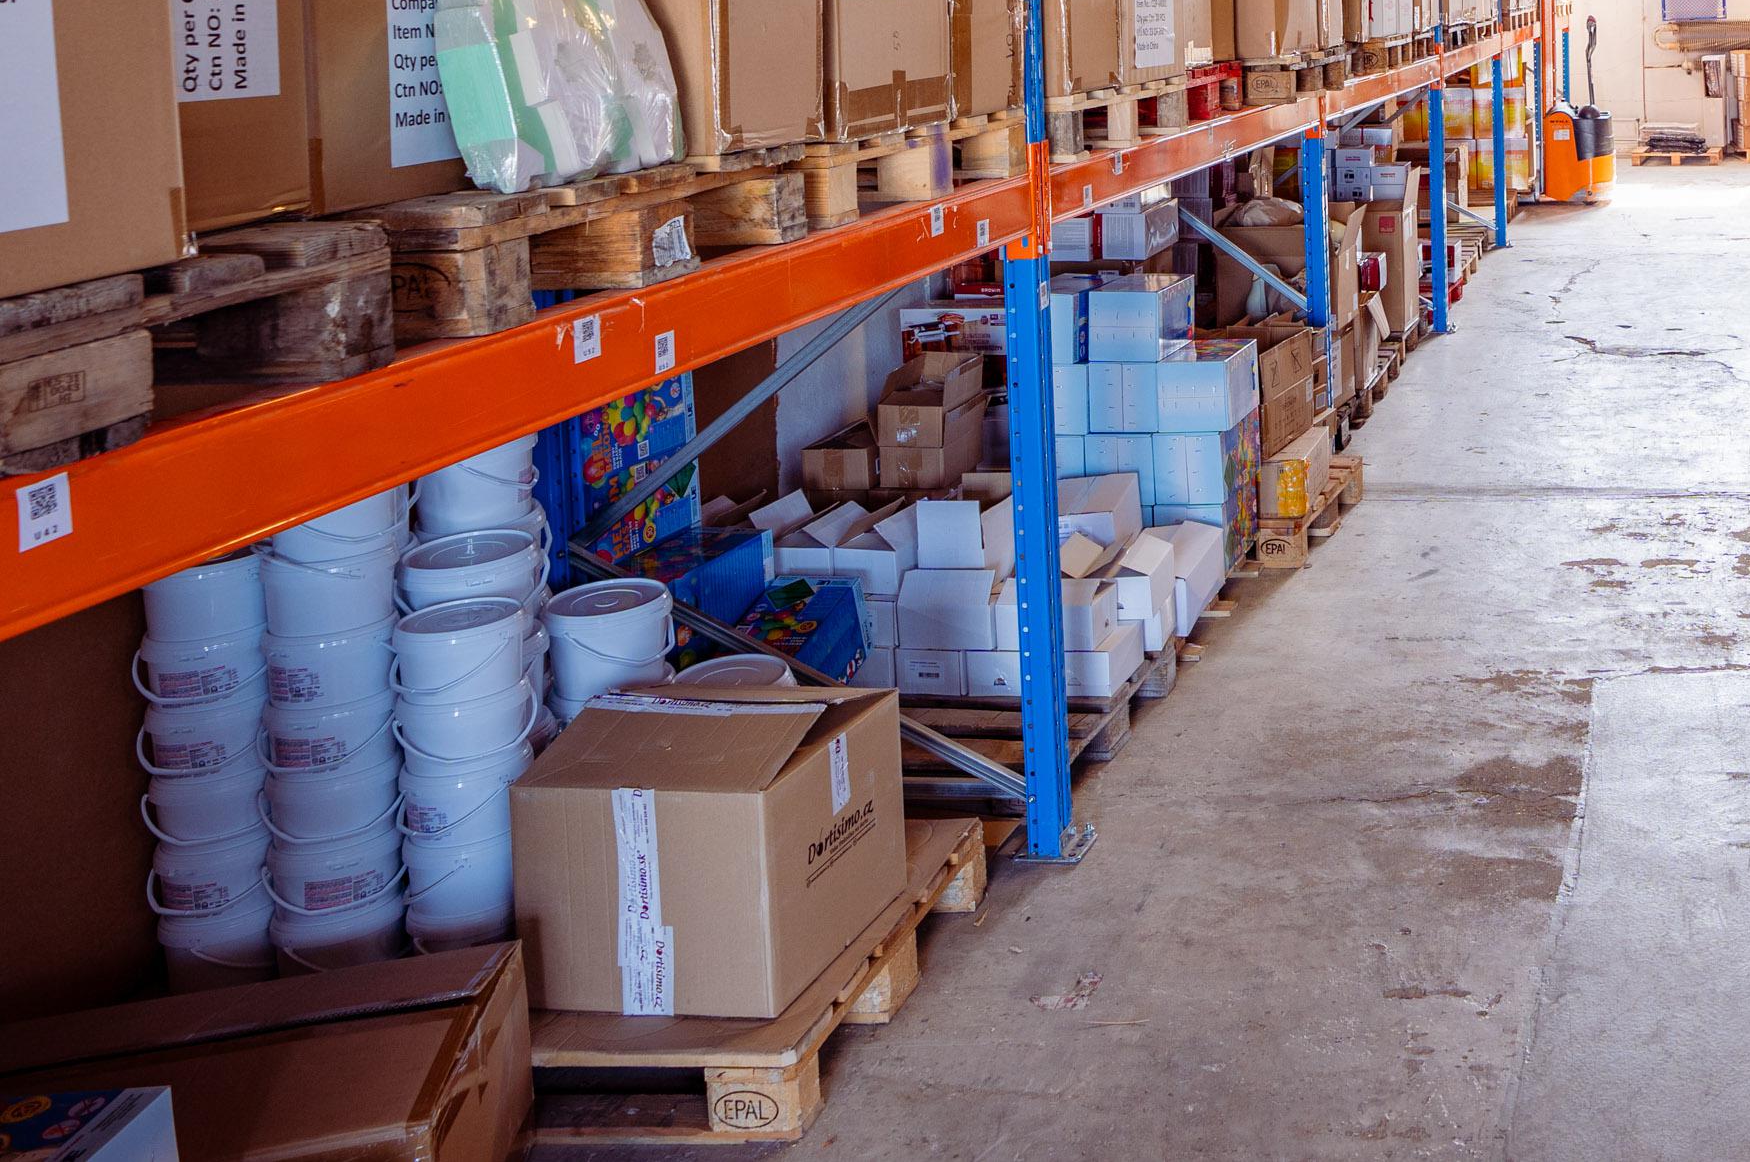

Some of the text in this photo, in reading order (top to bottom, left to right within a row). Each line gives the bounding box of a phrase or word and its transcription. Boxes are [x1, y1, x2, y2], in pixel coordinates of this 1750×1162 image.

[231, 3, 245, 21] in
[183, 10, 198, 46] per
[206, 8, 221, 47] NO:
[393, 24, 421, 39] Item
[182, 53, 199, 92] Qty
[208, 55, 222, 90] Ctn
[232, 29, 247, 88] Made
[394, 53, 416, 71] Qty
[395, 83, 415, 98] Ctn
[396, 109, 445, 128] Made in
[808, 800, 874, 866] Dortisimo.cz
[724, 1099, 770, 1120] EPAL
